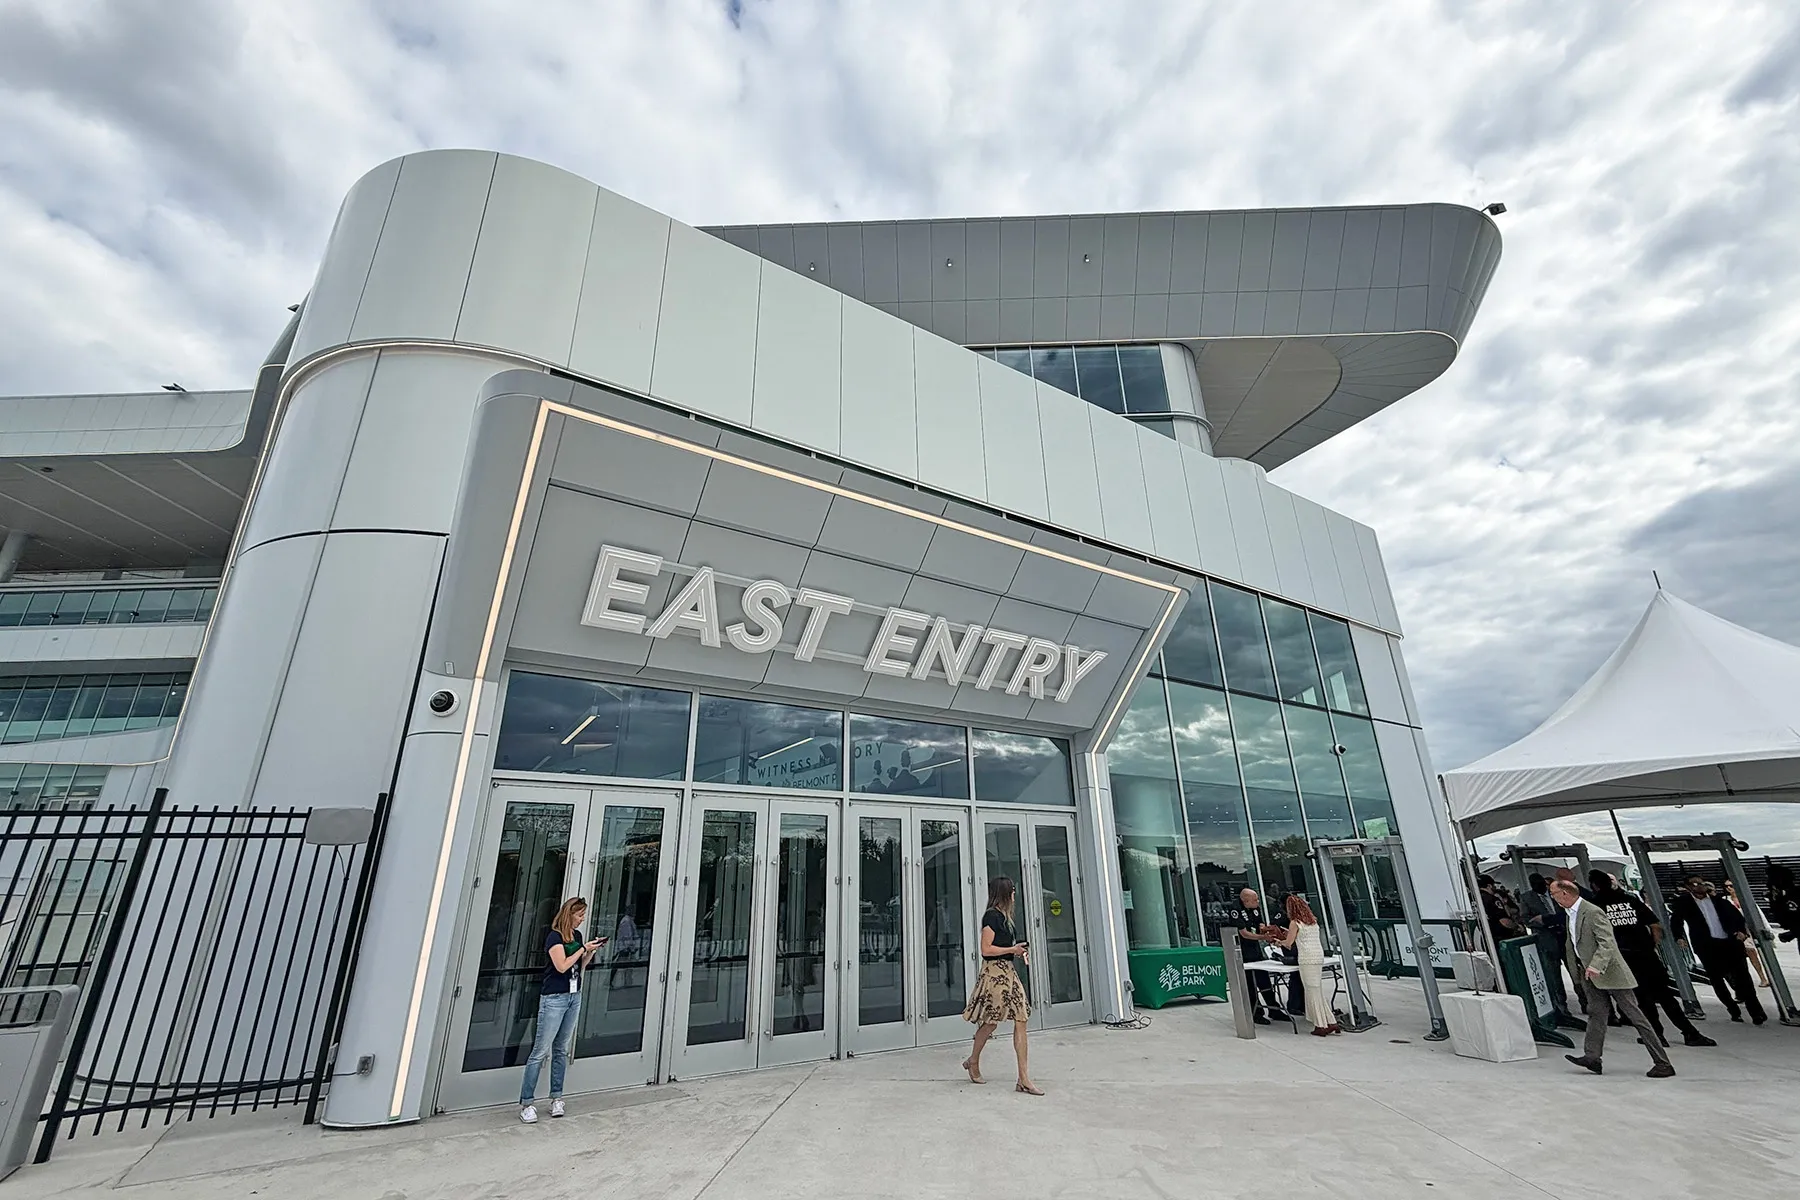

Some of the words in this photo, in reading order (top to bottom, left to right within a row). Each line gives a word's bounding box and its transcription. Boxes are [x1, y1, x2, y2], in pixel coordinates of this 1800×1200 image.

[580, 543, 855, 662] EAST
[863, 607, 1109, 703] ENTRY
[757, 757, 811, 779] WITNESS
[792, 774, 830, 789] BELMONT
[1606, 903, 1632, 912] APEX
[1606, 910, 1637, 919] SECURITY
[1611, 917, 1637, 926] GROUP
[1182, 965, 1222, 976] BELMONT
[1182, 976, 1206, 986] PARK
